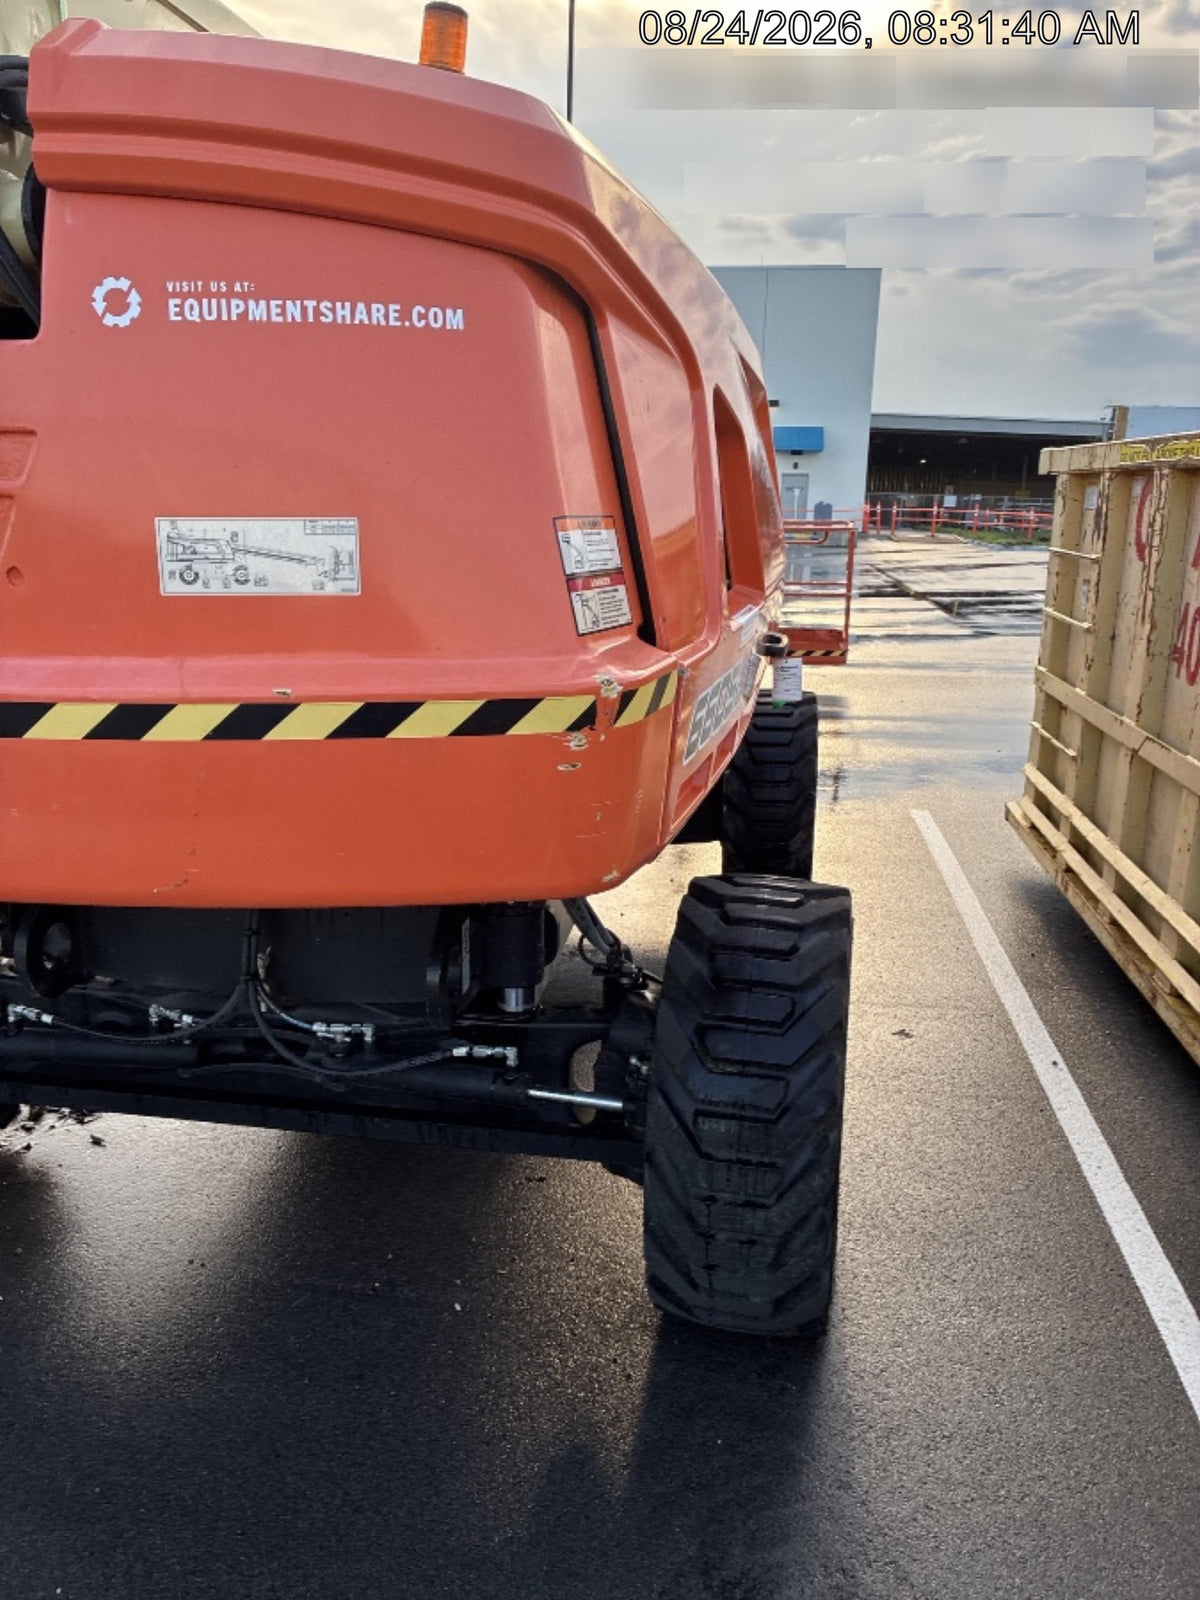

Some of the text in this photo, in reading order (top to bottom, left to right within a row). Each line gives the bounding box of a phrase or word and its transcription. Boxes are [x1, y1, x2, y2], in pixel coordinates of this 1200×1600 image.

[166, 281, 256, 293] VISIT US AT:
[167, 297, 465, 331] EQUIPMENTSHARE.COM
